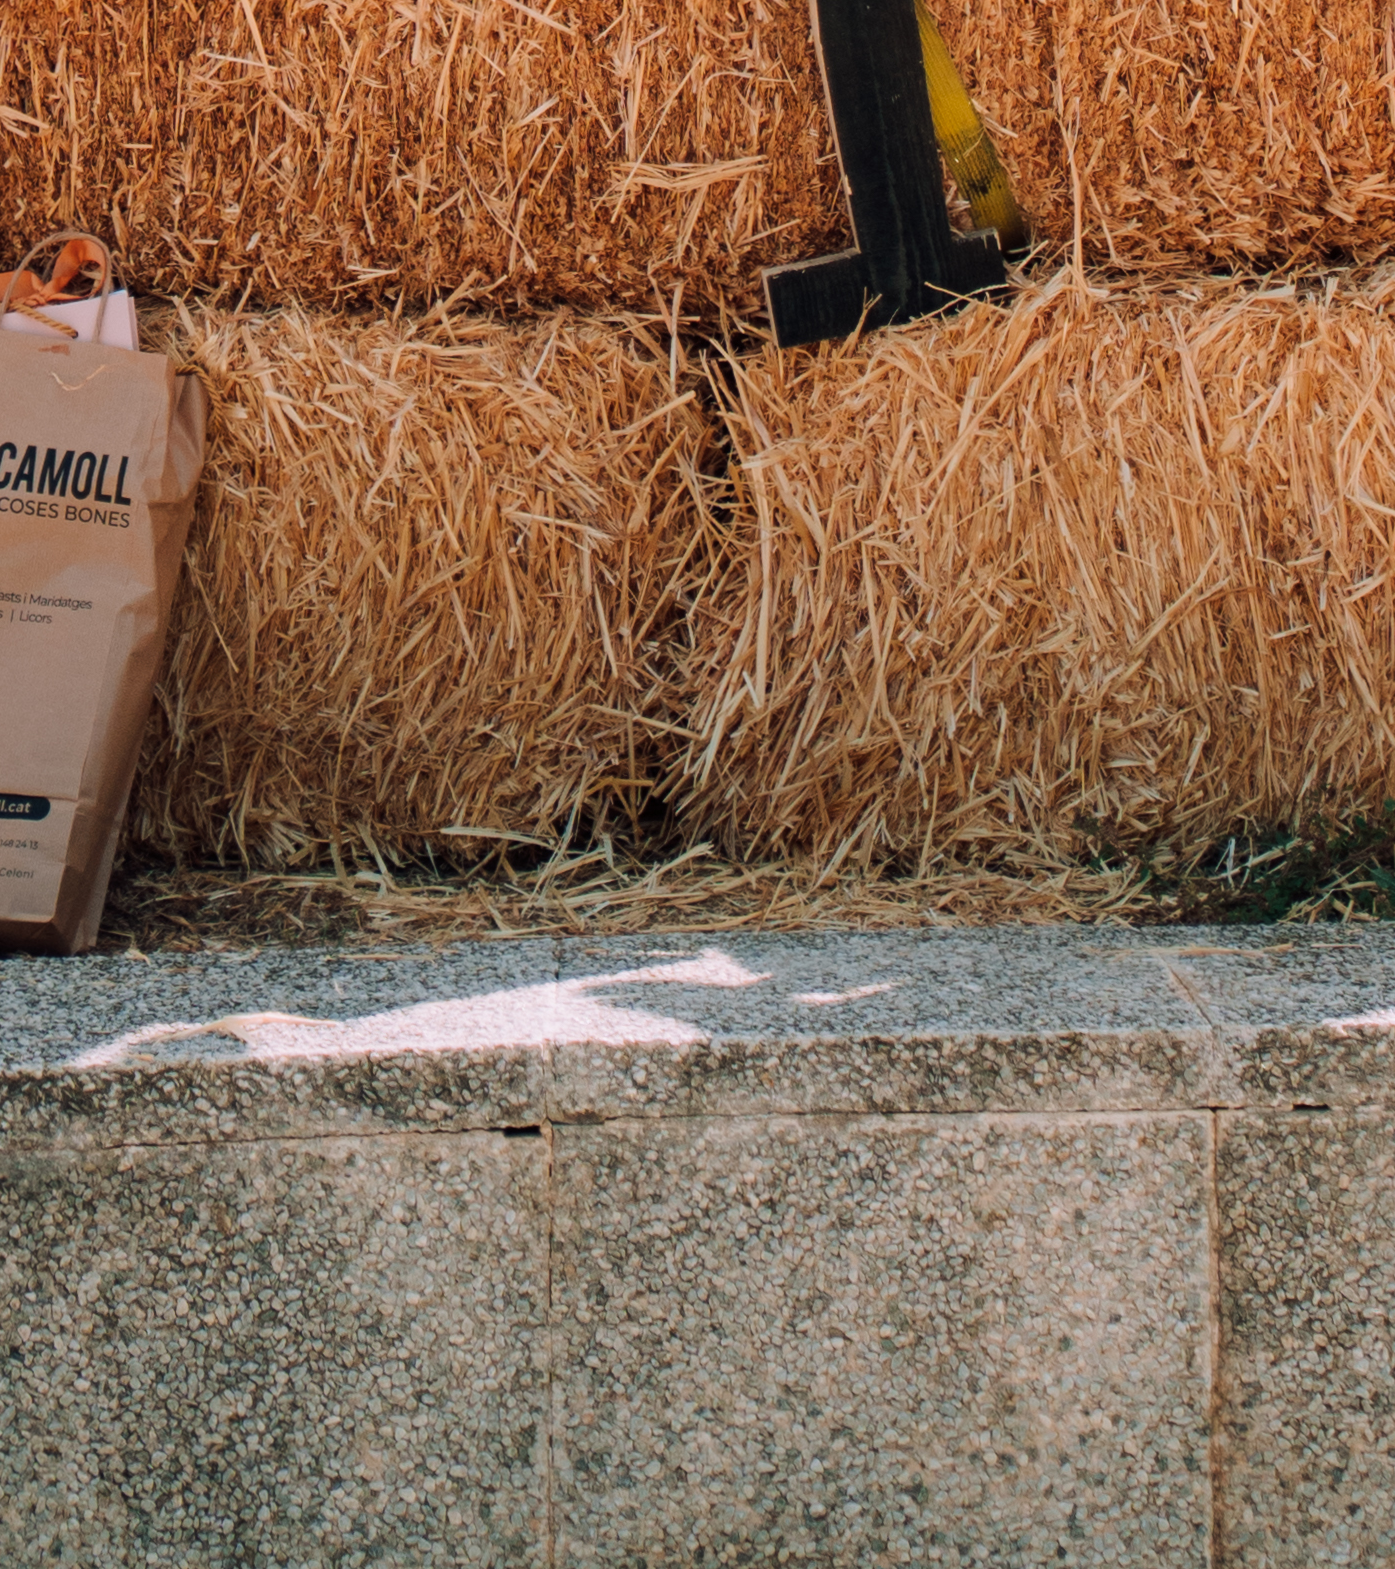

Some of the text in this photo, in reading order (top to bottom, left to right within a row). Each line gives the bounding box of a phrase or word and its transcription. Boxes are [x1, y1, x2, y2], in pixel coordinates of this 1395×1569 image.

[64, 505, 130, 529] BONES
[29, 593, 93, 611] Maridatges
[19, 610, 53, 625] Licors
